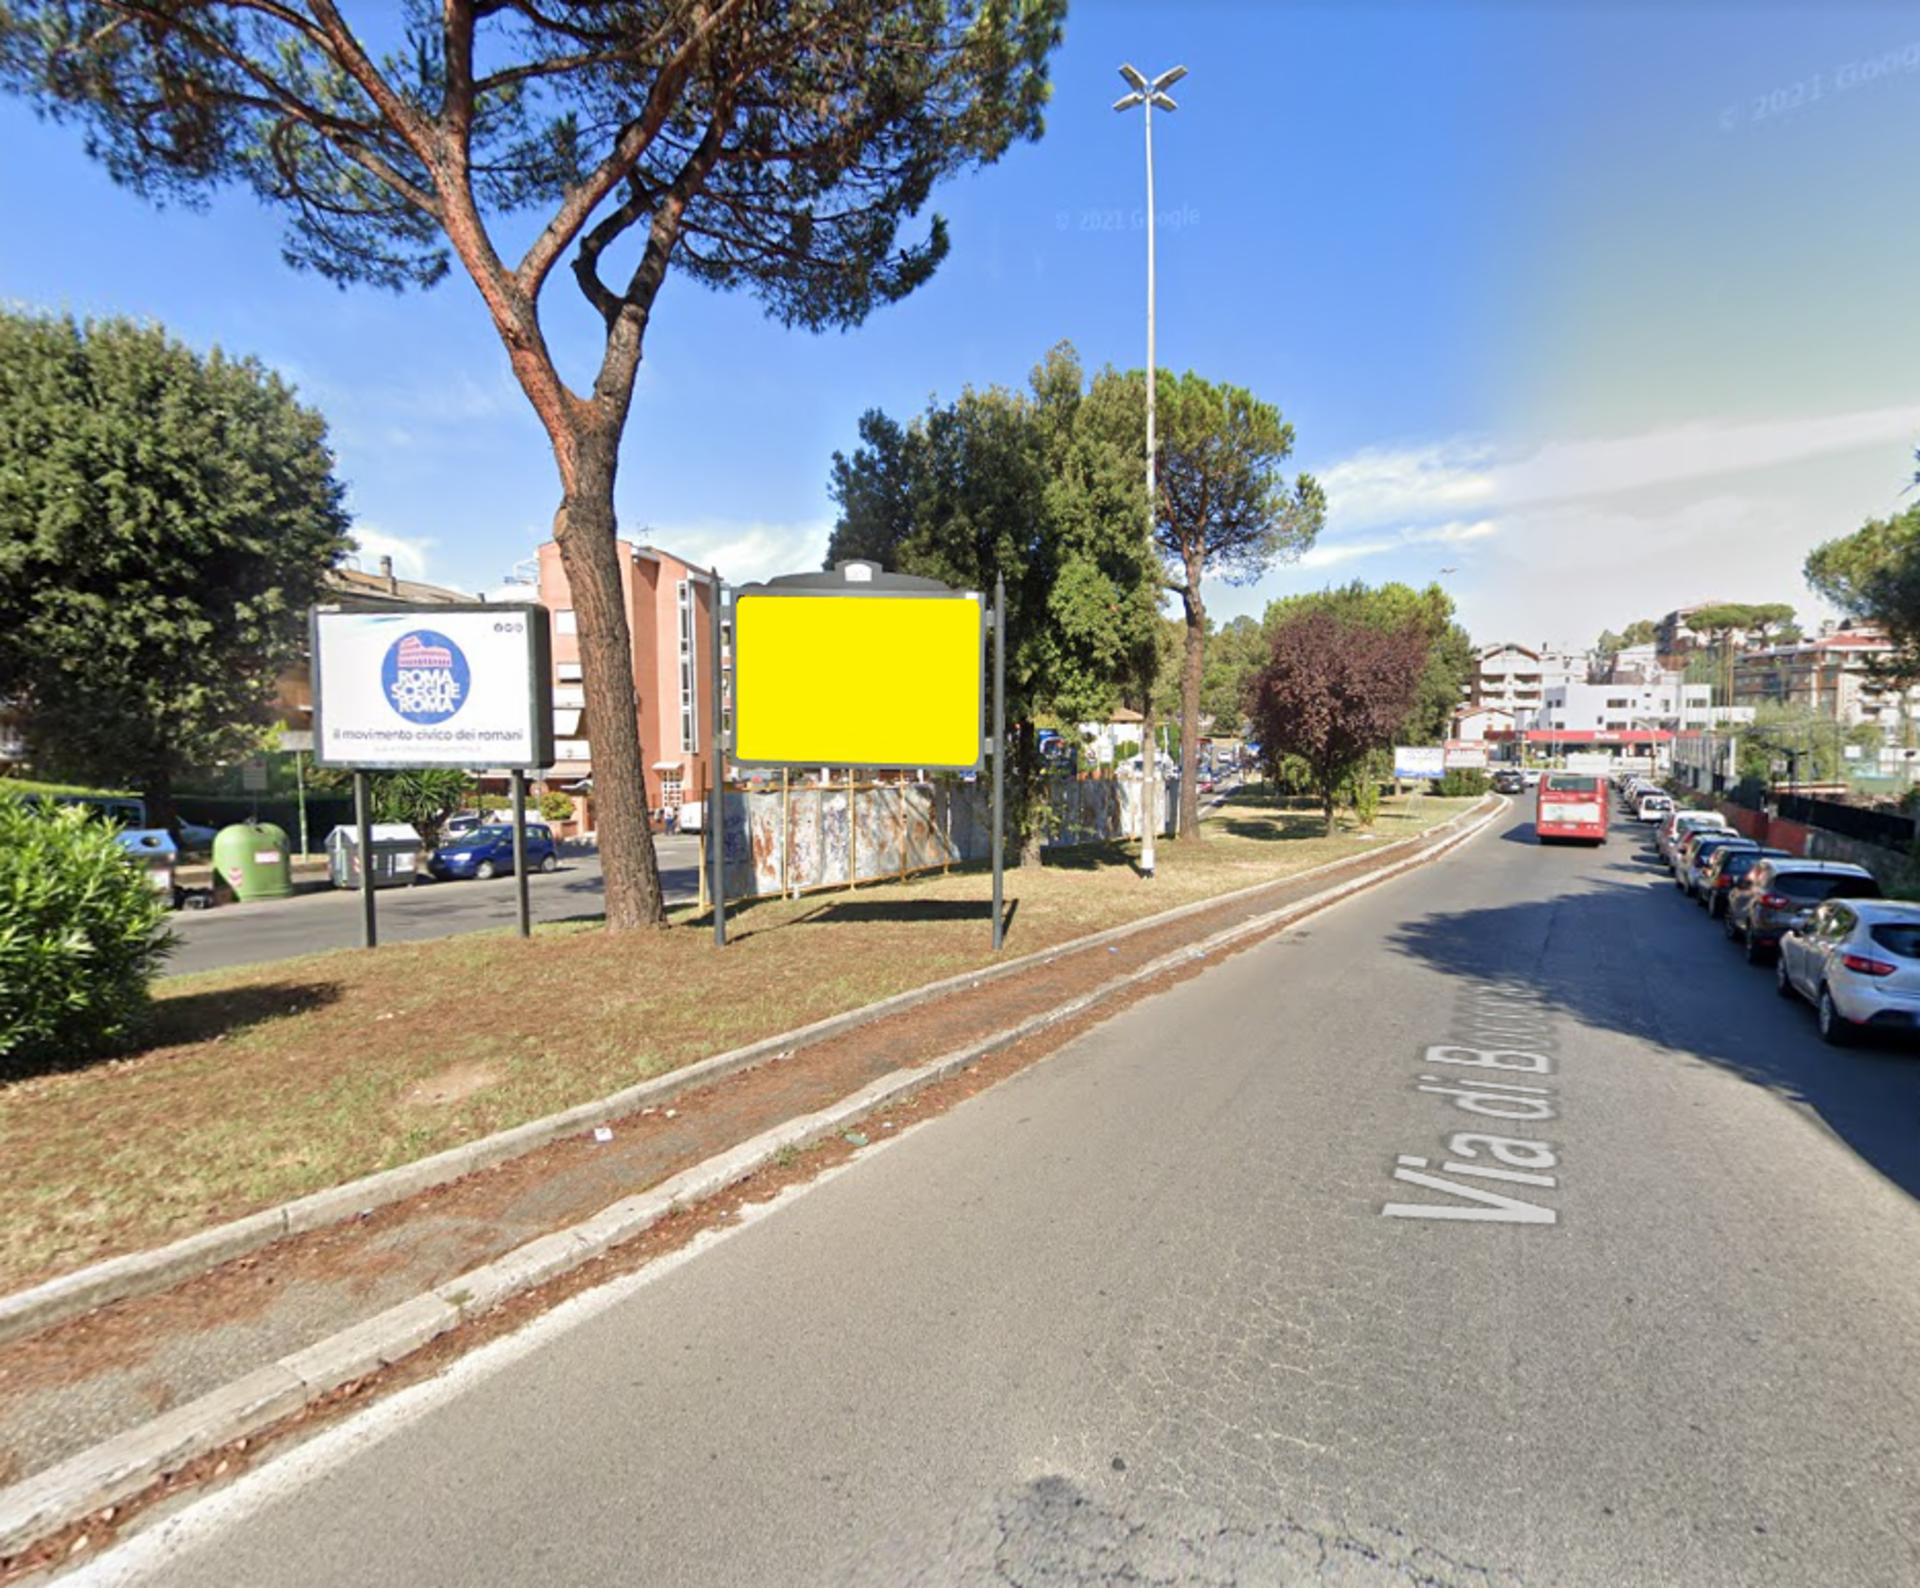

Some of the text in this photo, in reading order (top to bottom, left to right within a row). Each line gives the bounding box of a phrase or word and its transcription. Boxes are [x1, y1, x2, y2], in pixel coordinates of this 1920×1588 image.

[398, 668, 454, 684] ROMA
[398, 697, 456, 712] ROMA
[343, 728, 412, 741] movimento
[416, 728, 453, 741] civico
[456, 728, 476, 741] dei
[478, 728, 523, 741] romani
